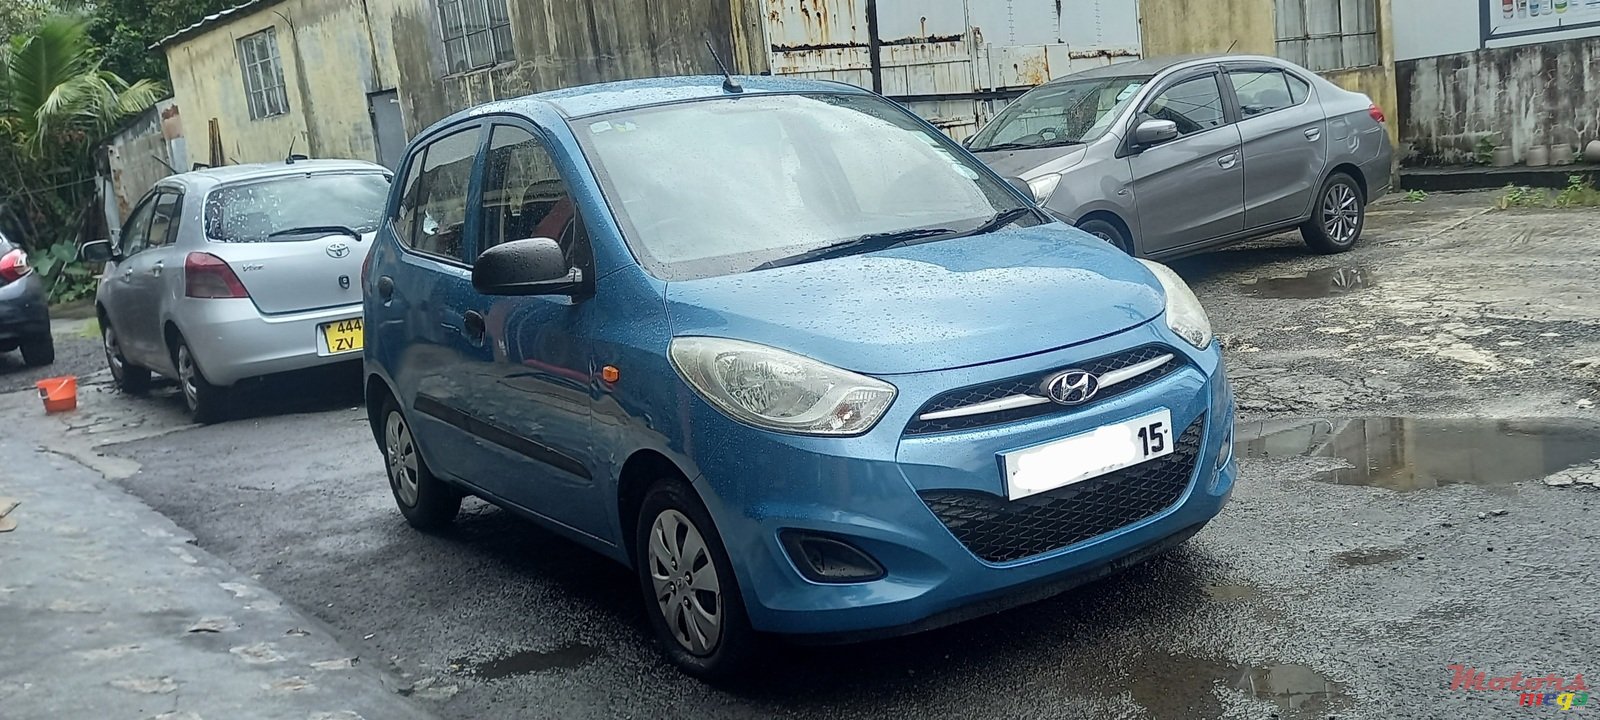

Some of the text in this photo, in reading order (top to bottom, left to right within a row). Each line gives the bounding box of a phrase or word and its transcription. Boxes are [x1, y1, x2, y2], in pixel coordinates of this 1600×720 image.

[337, 320, 362, 334] 444
[336, 337, 354, 351] ZV
[1138, 421, 1165, 456] 15
